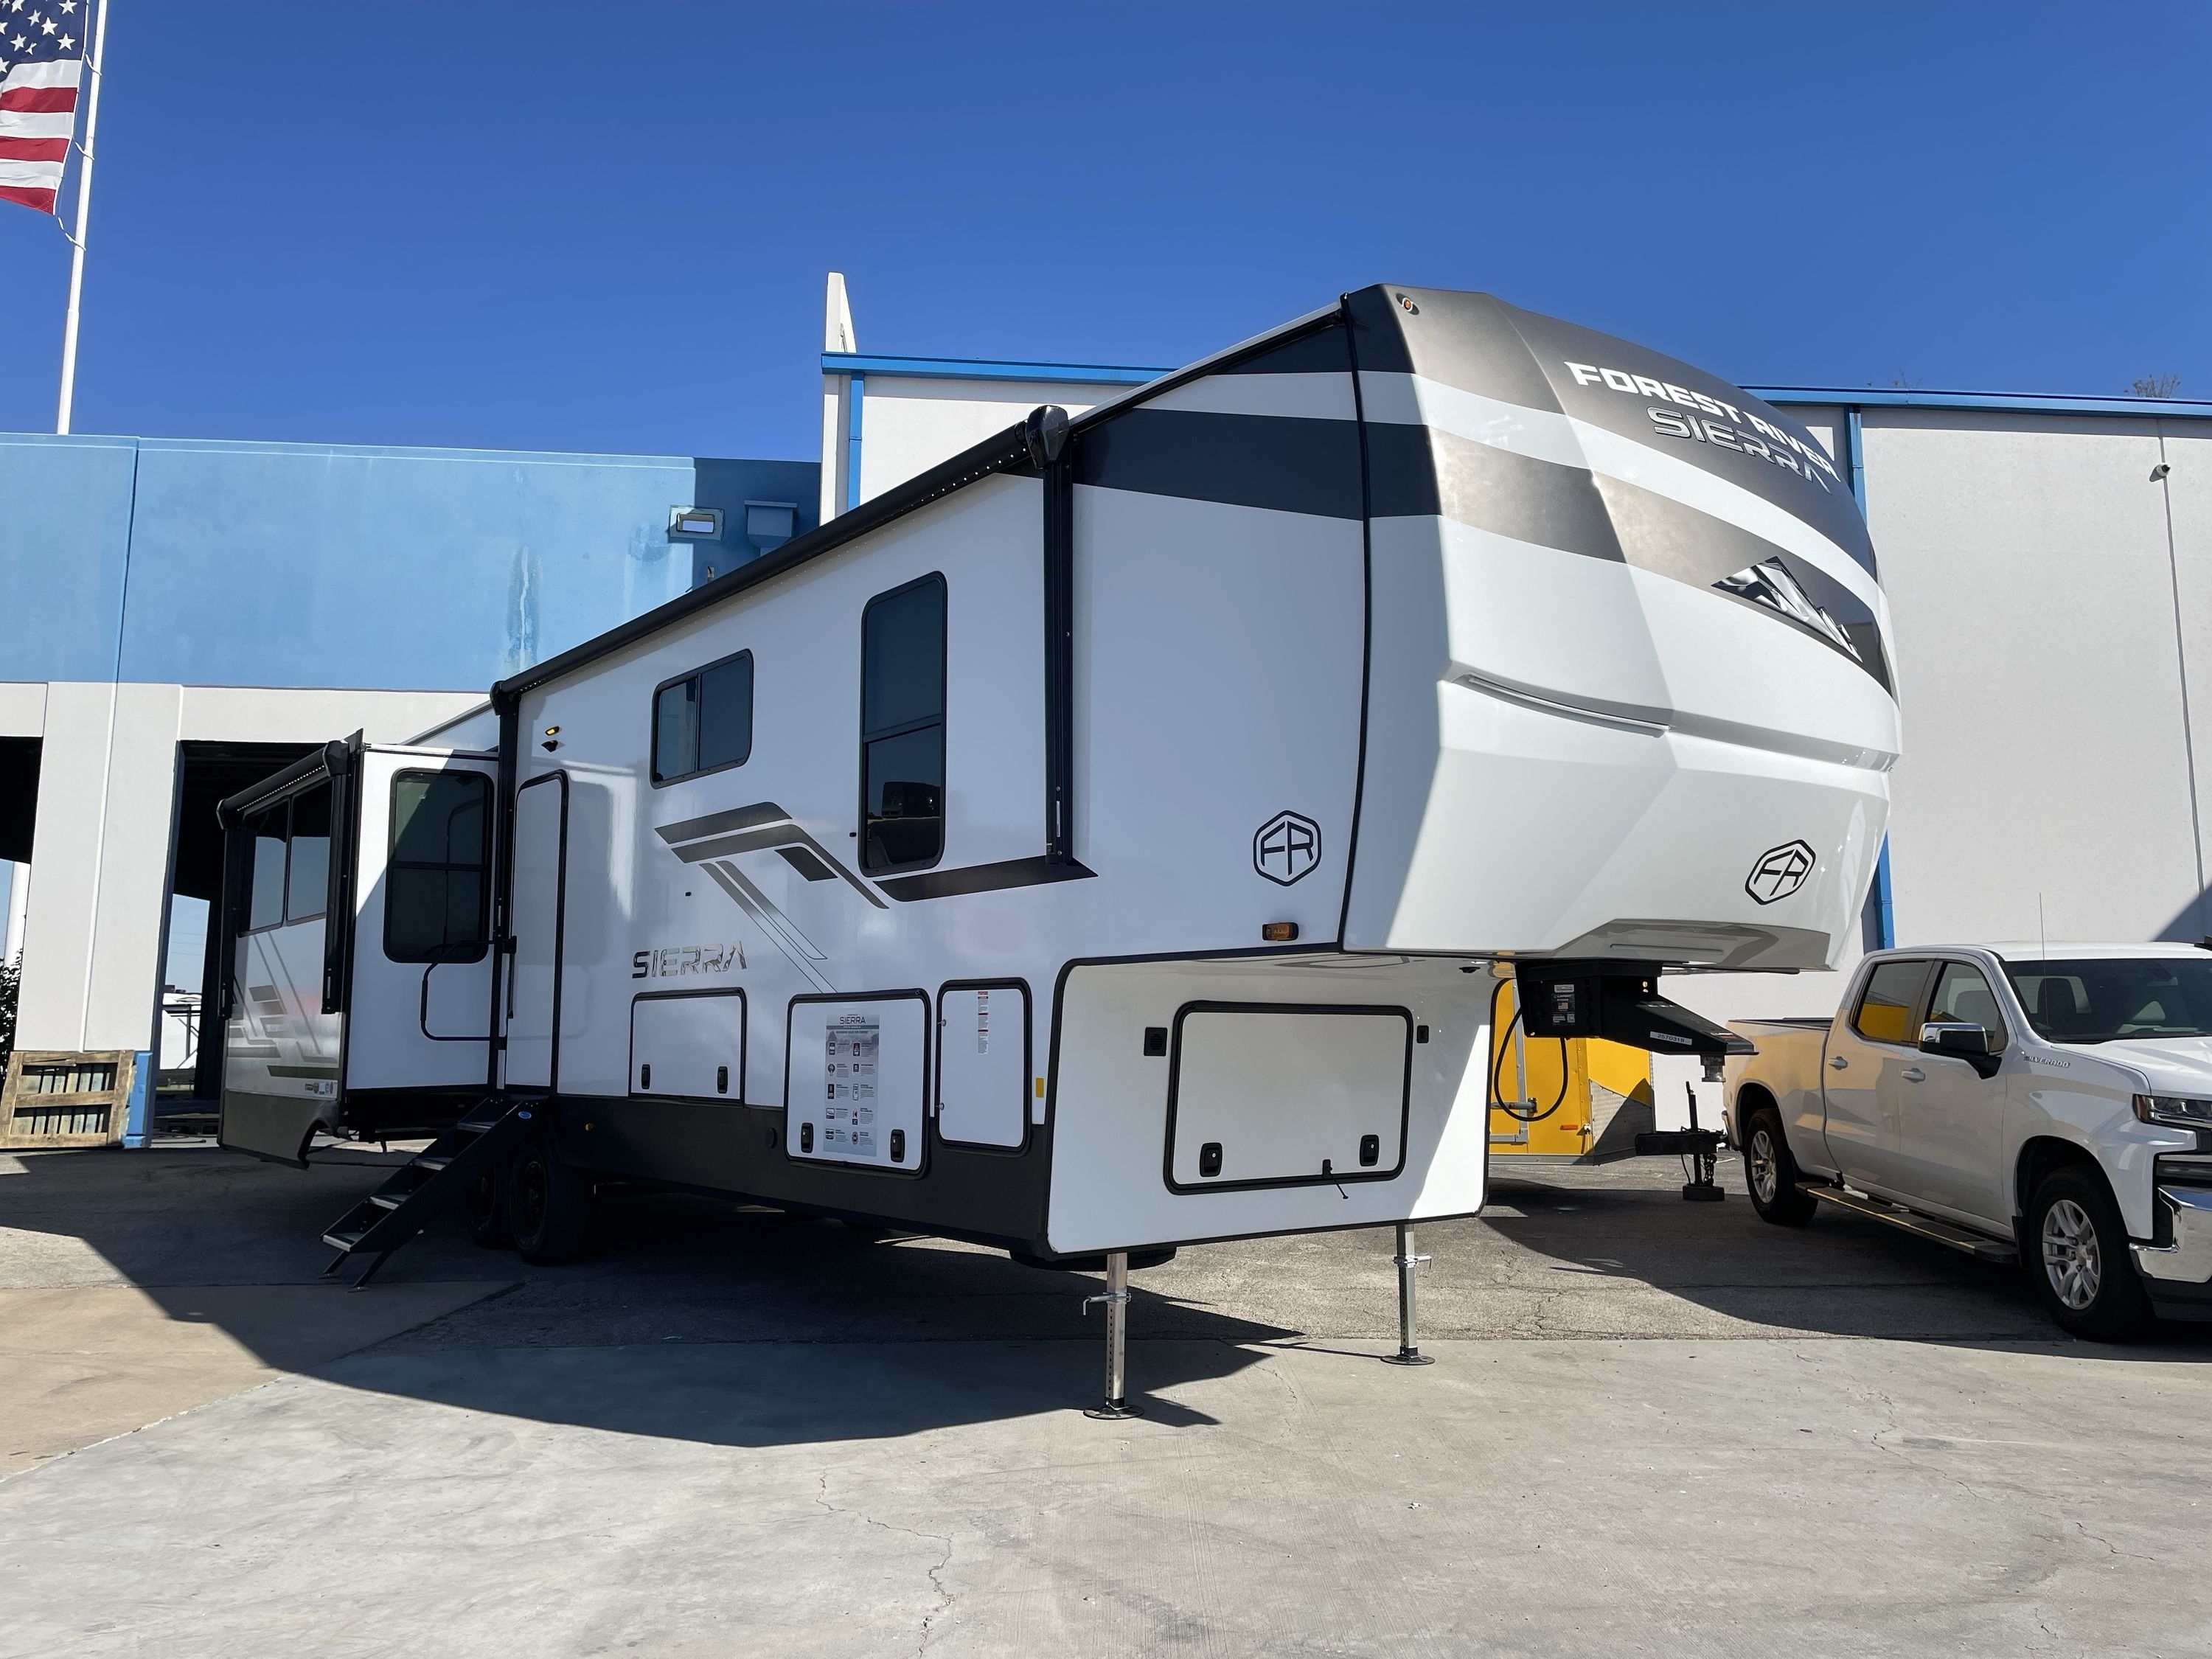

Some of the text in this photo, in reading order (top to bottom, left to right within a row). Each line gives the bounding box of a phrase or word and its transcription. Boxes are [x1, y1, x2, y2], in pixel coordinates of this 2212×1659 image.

[1563, 361, 1841, 482] FOREST RIVER
[1648, 407, 1832, 494] SIERRA
[632, 940, 747, 978] SIERRA
[839, 1016, 866, 1025] SIERRA
